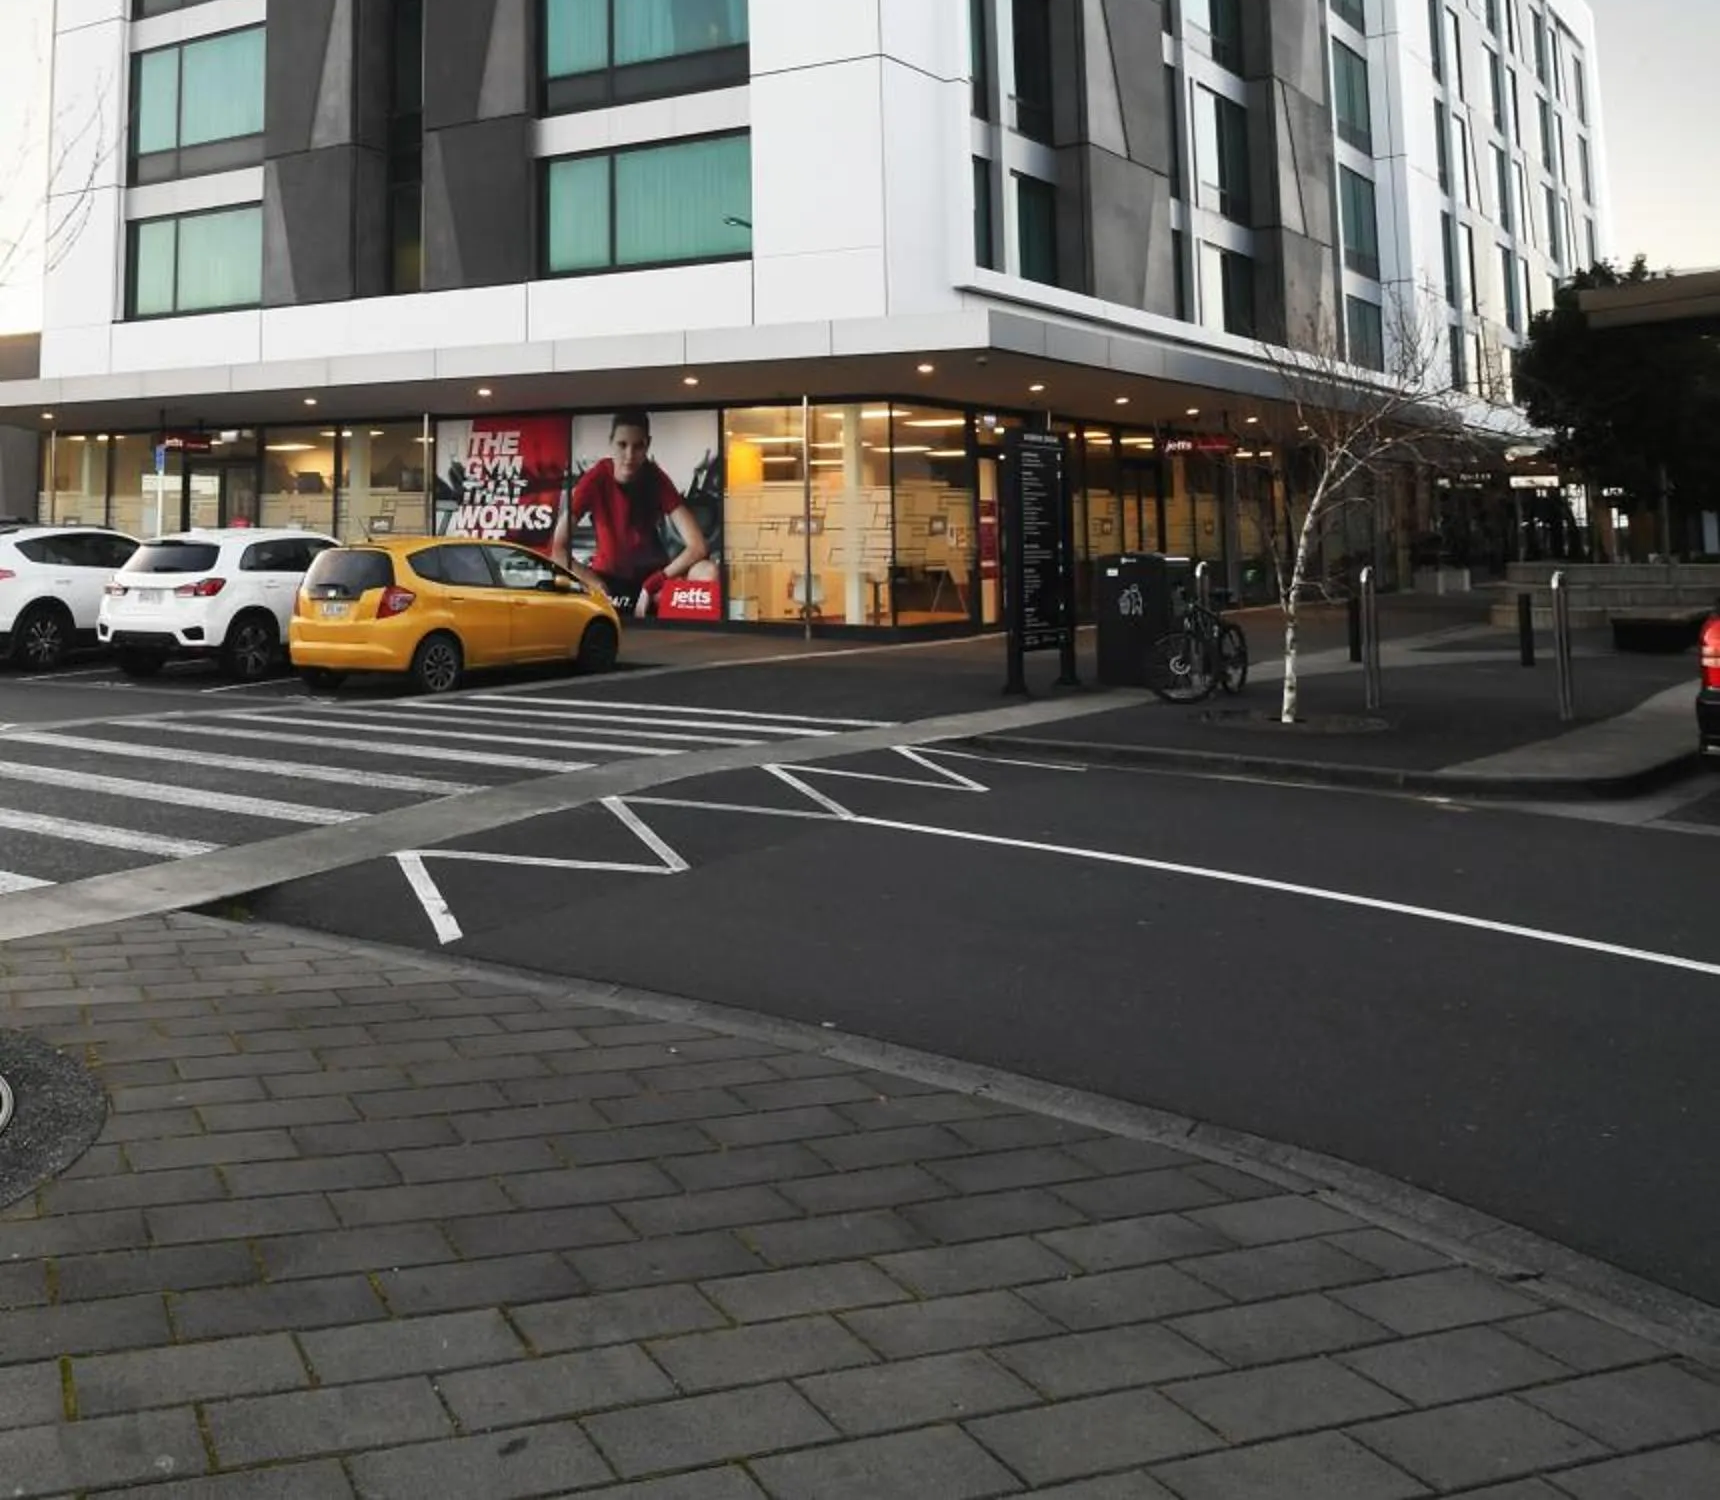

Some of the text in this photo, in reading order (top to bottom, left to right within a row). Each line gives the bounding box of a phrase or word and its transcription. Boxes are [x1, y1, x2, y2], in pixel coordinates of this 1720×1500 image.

[469, 431, 521, 455] THE
[465, 455, 524, 479] GYM
[462, 480, 529, 505] THAT
[456, 505, 553, 530] WORKS
[670, 587, 712, 607] jetts
